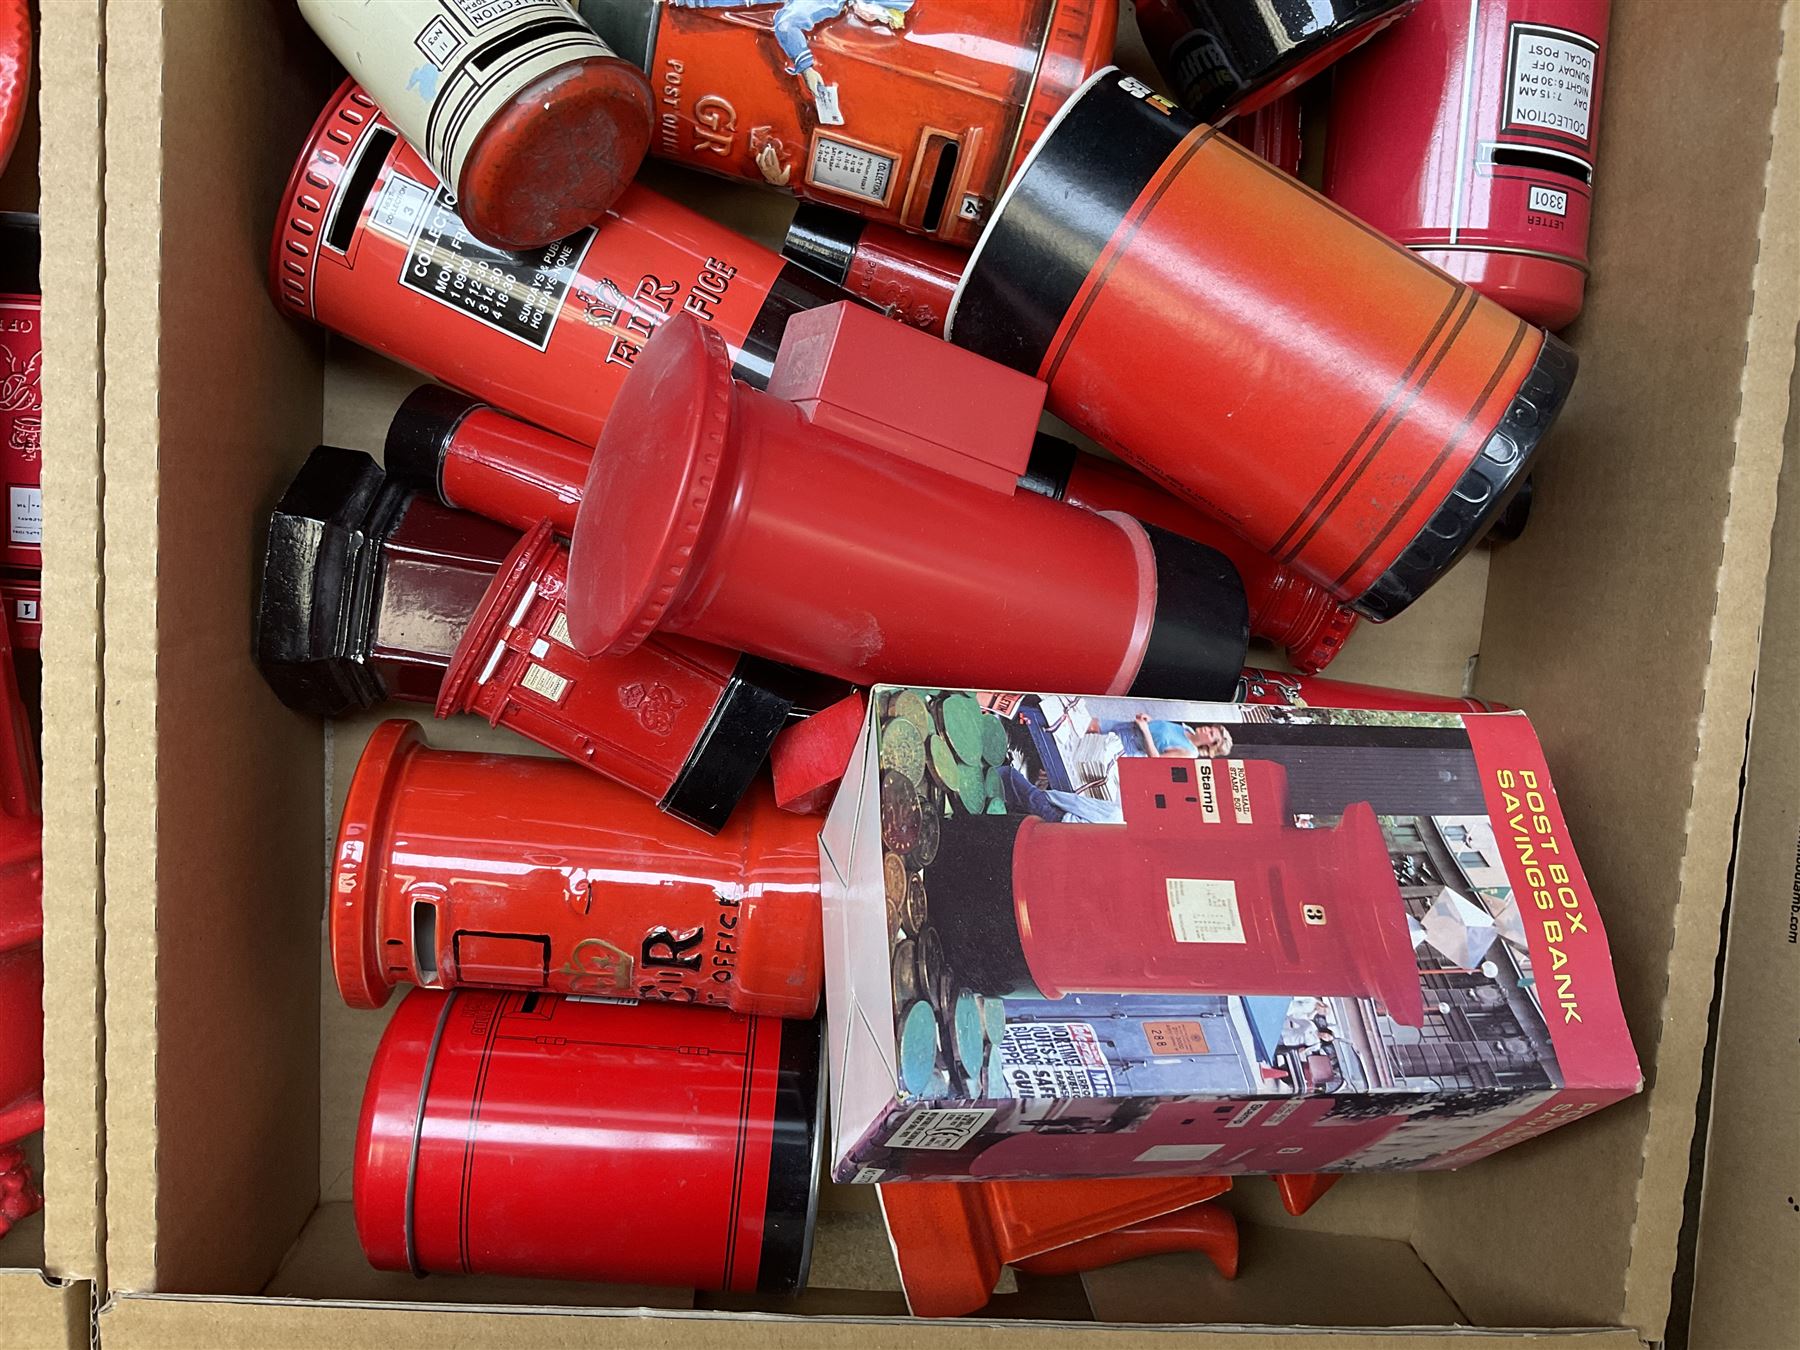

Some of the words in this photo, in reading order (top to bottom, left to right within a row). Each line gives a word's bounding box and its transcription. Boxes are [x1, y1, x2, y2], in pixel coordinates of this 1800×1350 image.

[1528, 45, 1559, 58] POST
[1565, 51, 1591, 68] LOCAL
[1520, 73, 1539, 83] PM
[1531, 61, 1555, 72] OFF
[1558, 65, 1590, 84] SUNDAY
[665, 58, 684, 104] POST
[1519, 86, 1538, 96] AM
[1565, 83, 1589, 97] NIGHT
[1573, 100, 1588, 111] DAY
[694, 95, 737, 156] GR
[1516, 108, 1586, 135] COLLECTION
[386, 185, 408, 225] COLLECTION
[403, 206, 414, 217] 3
[1535, 191, 1564, 210] 3301
[414, 193, 458, 278] COLLECTIO
[1527, 216, 1564, 231] LETTER
[544, 239, 563, 264] PUBL
[435, 263, 453, 294] MON
[454, 258, 473, 290] 0900
[469, 261, 490, 296] 12-30
[540, 264, 550, 272] &
[450, 291, 461, 299] 1
[483, 267, 504, 301] 14-30
[496, 274, 517, 308] 18-30
[684, 255, 738, 321] FICE
[465, 298, 477, 307] 2
[478, 304, 489, 314] 3
[518, 272, 545, 323] SUNDAYS
[492, 311, 503, 320] 4
[1200, 765, 1214, 813] Stamp
[1229, 767, 1239, 793] STAMP
[1237, 767, 1247, 792] ROYAL
[1241, 795, 1250, 815] MAIL
[1519, 768, 1560, 855] POST
[1549, 865, 1588, 934] BOX
[1496, 768, 1555, 911] SAVINGS
[1542, 920, 1584, 1026] BANK
[1306, 906, 1324, 921] 3
[1010, 1026, 1043, 1066] BULLDOG
[1028, 1026, 1057, 1055] QUITS
[1152, 1029, 1168, 1047] 288
[1075, 1070, 1091, 1098] TERRO
